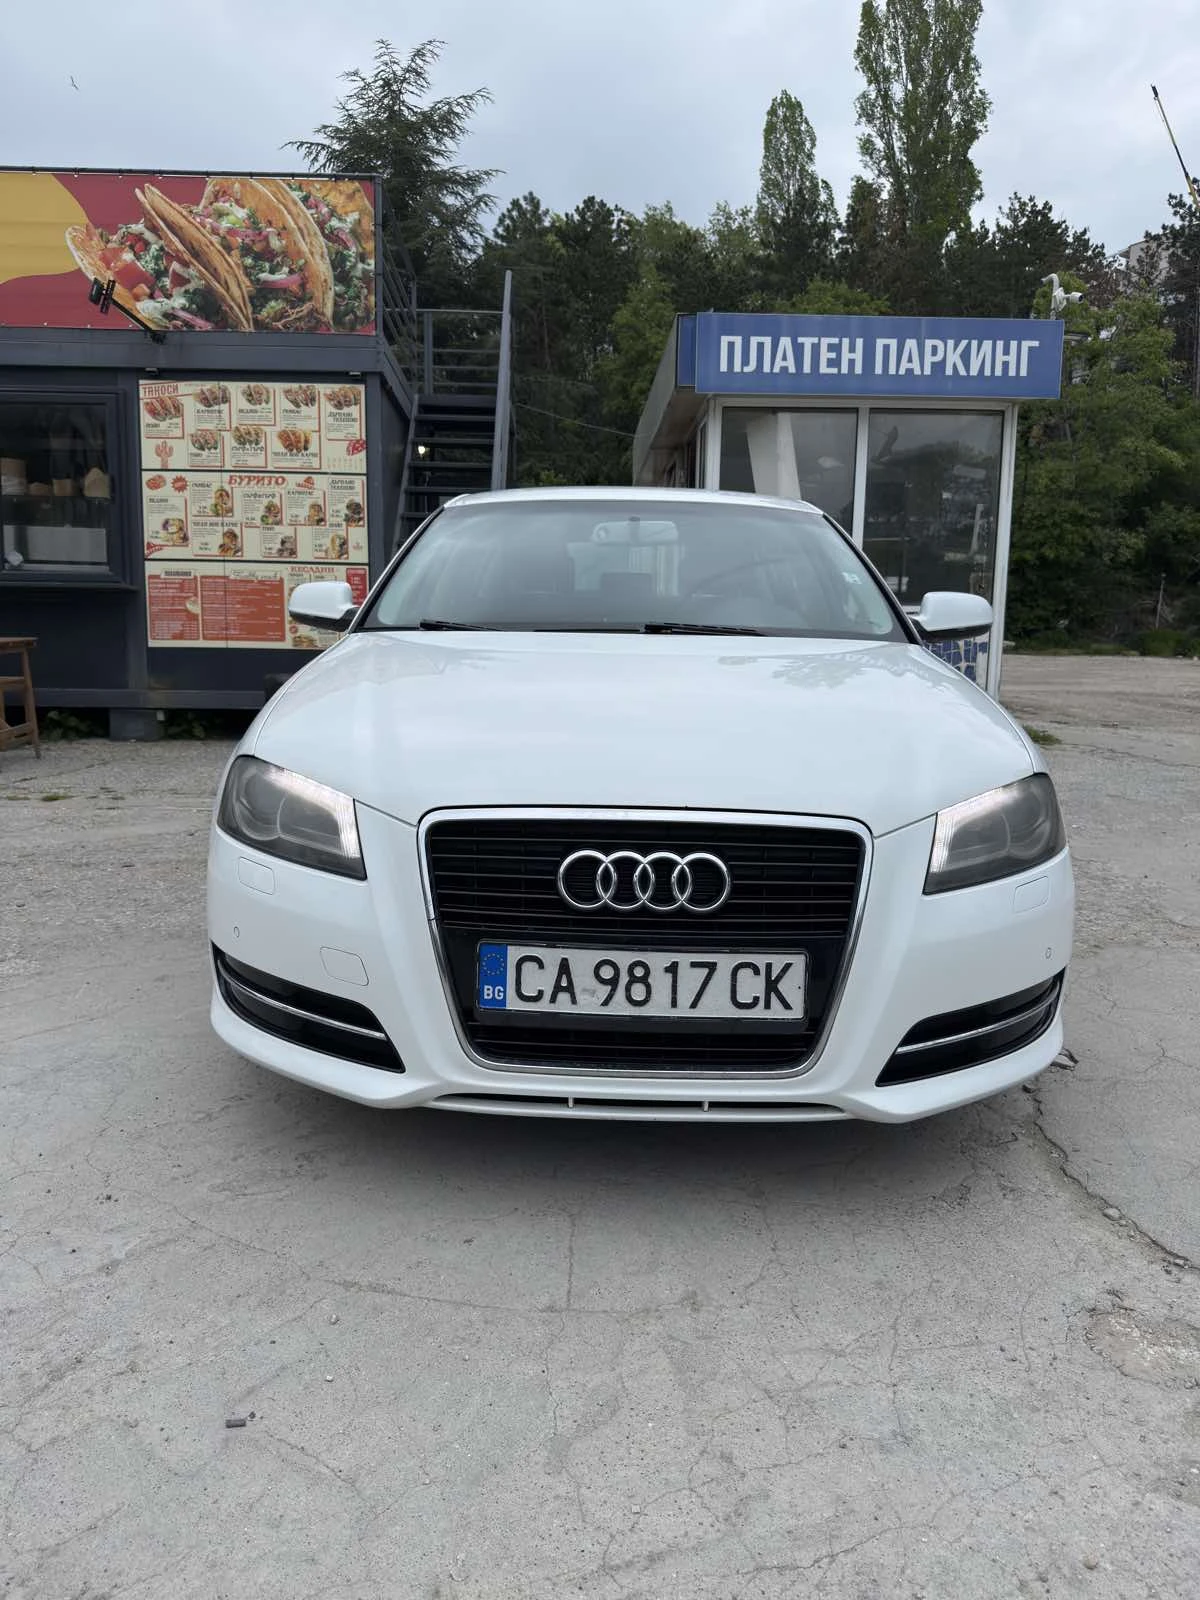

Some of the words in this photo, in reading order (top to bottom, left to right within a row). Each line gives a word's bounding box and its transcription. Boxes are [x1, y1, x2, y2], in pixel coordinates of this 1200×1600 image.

[719, 335, 864, 375] ПЛАТЕН
[875, 337, 1040, 377] ПАРКИНГ
[228, 475, 286, 486] БУРИТО
[483, 985, 505, 1000] BG
[514, 954, 578, 1005] CA
[593, 958, 718, 1009] 9817
[729, 960, 795, 1011] CK
